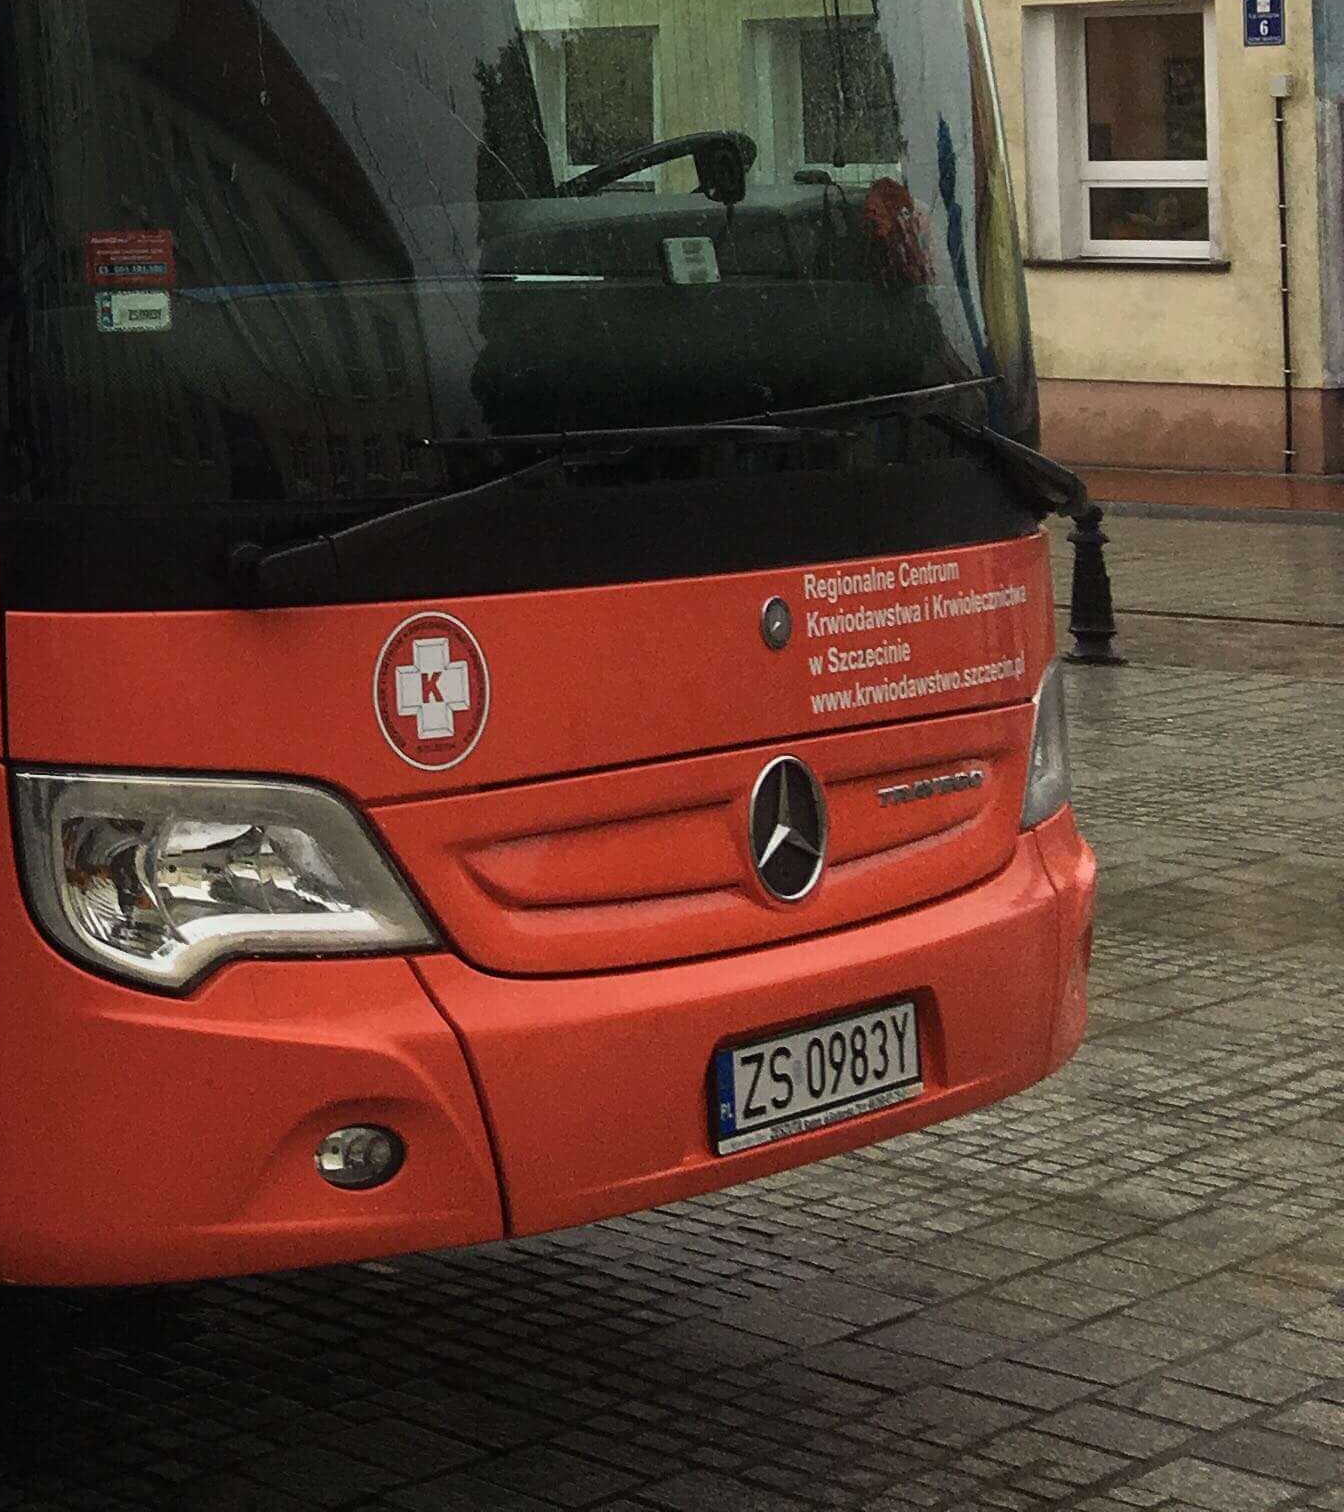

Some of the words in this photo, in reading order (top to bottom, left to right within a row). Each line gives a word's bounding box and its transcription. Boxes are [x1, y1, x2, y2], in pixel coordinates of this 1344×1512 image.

[1259, 19, 1269, 36] 6
[803, 566, 896, 604] Regionalne
[898, 561, 960, 588] Centrum
[806, 602, 922, 639] Krwiodawstwa
[923, 596, 930, 621] i
[932, 583, 1027, 620] Krwiolecznictwa
[808, 655, 824, 676] w
[827, 637, 912, 674] Szczecinie
[420, 671, 444, 704] K
[740, 1046, 795, 1119] ZS
[806, 1011, 910, 1099] 0983Y
